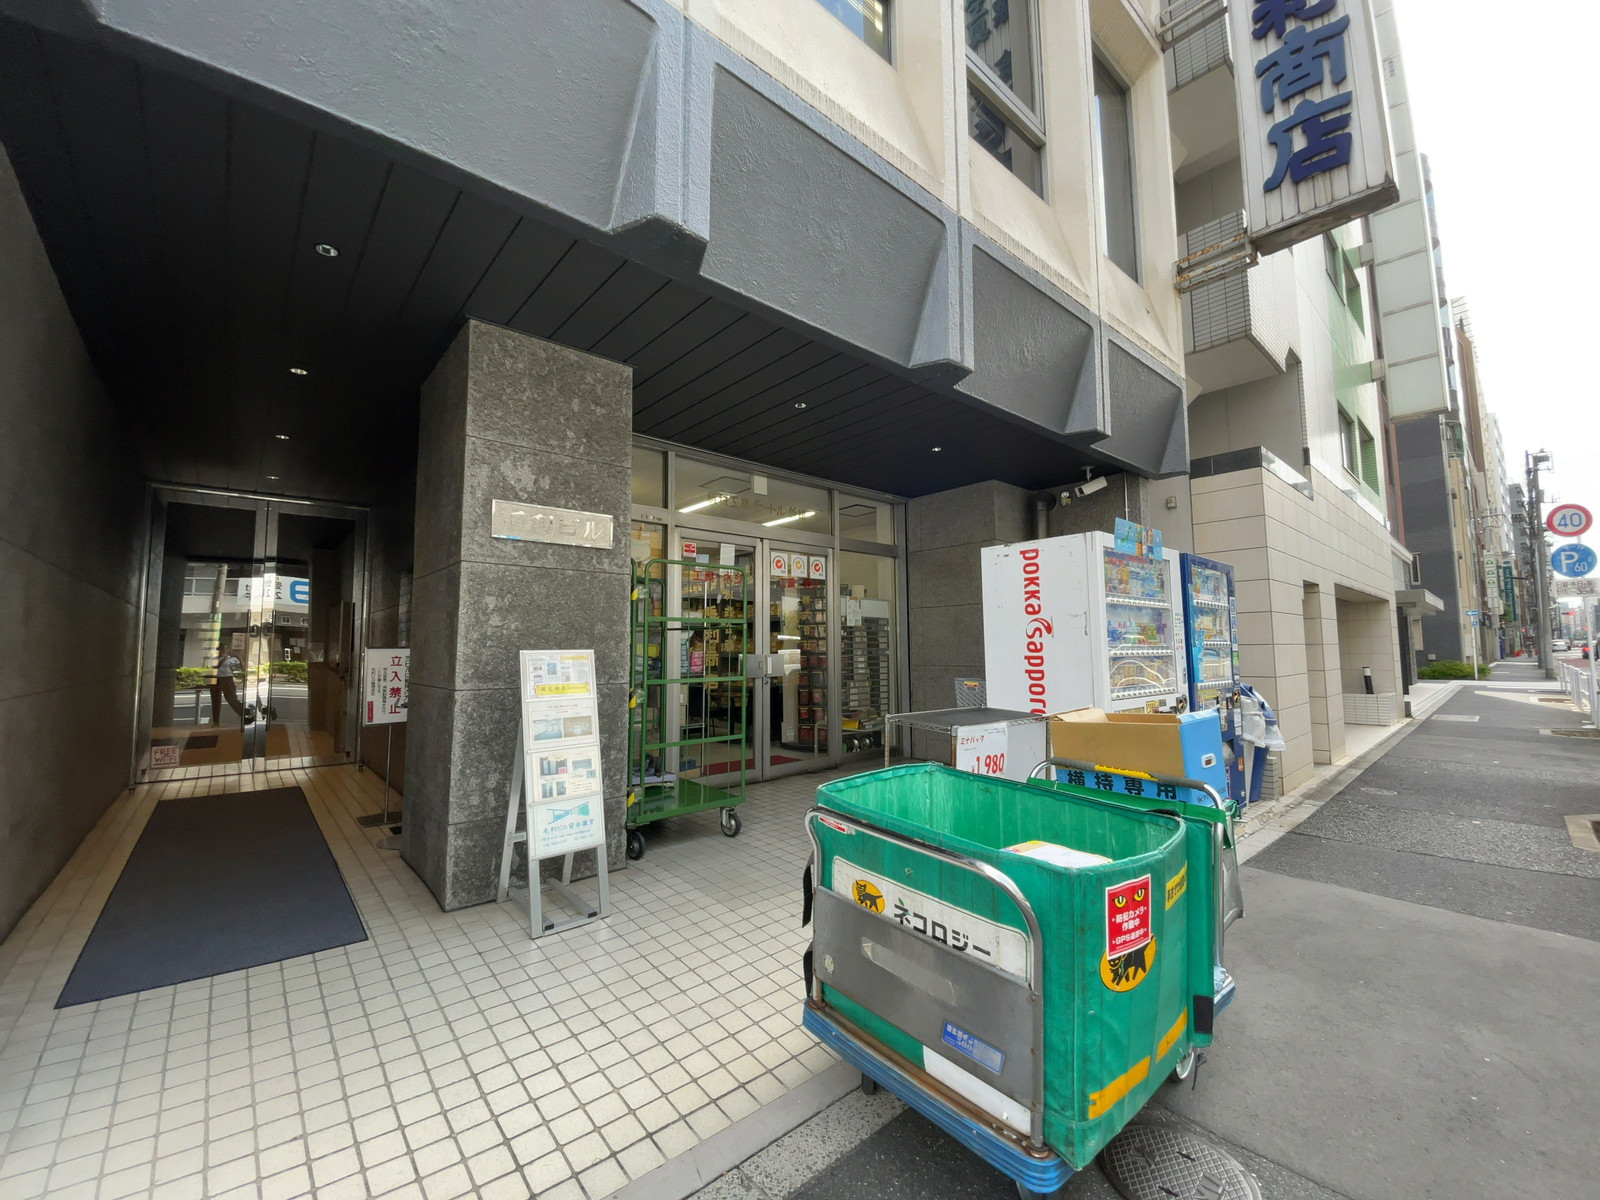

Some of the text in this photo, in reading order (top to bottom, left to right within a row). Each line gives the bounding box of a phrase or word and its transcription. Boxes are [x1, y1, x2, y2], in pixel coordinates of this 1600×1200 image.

[1557, 512, 1582, 528] 40
[1561, 551, 1588, 573] P 60
[389, 656, 402, 714] 立入禁止
[1067, 770, 1177, 800] 横持専用
[894, 903, 991, 956] ネコロジー
